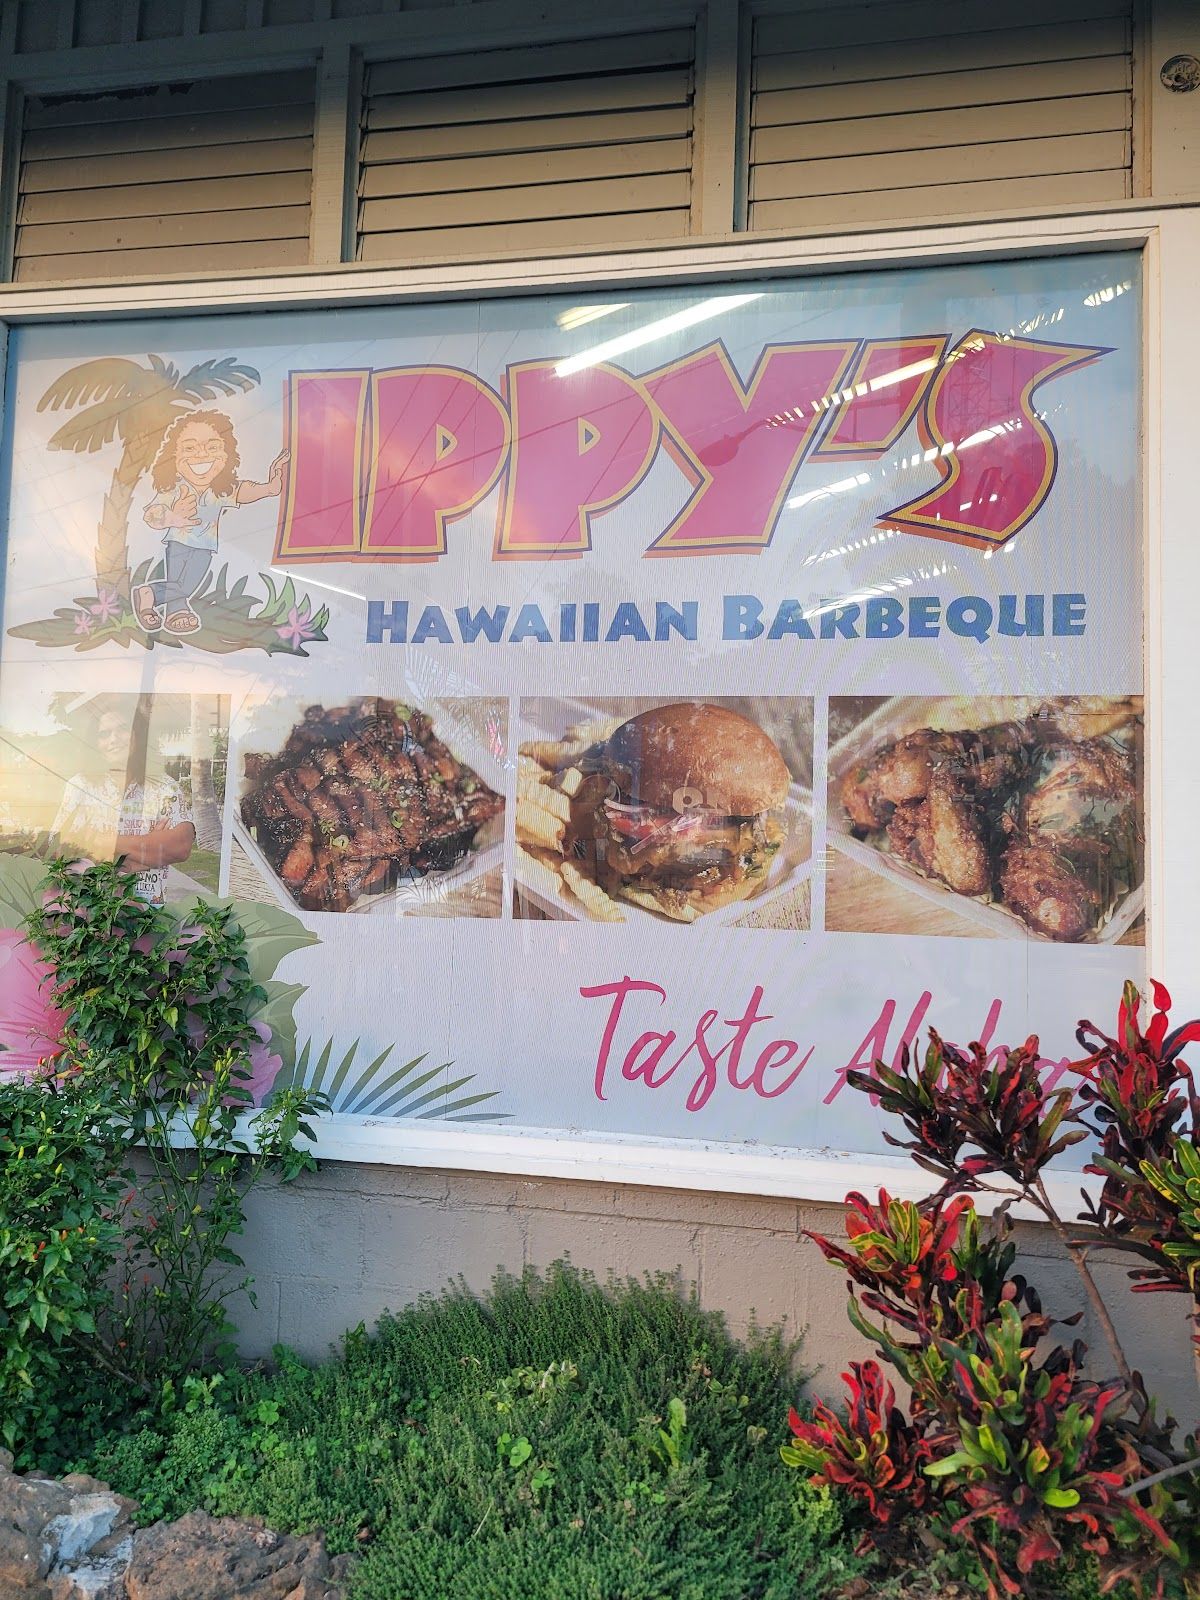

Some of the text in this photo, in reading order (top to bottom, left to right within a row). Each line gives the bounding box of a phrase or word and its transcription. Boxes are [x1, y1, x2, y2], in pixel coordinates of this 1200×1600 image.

[272, 328, 1118, 564] IPPY'S
[366, 593, 1087, 644] HAWAIIAN BARBEQUE
[579, 975, 814, 1112] Taste
